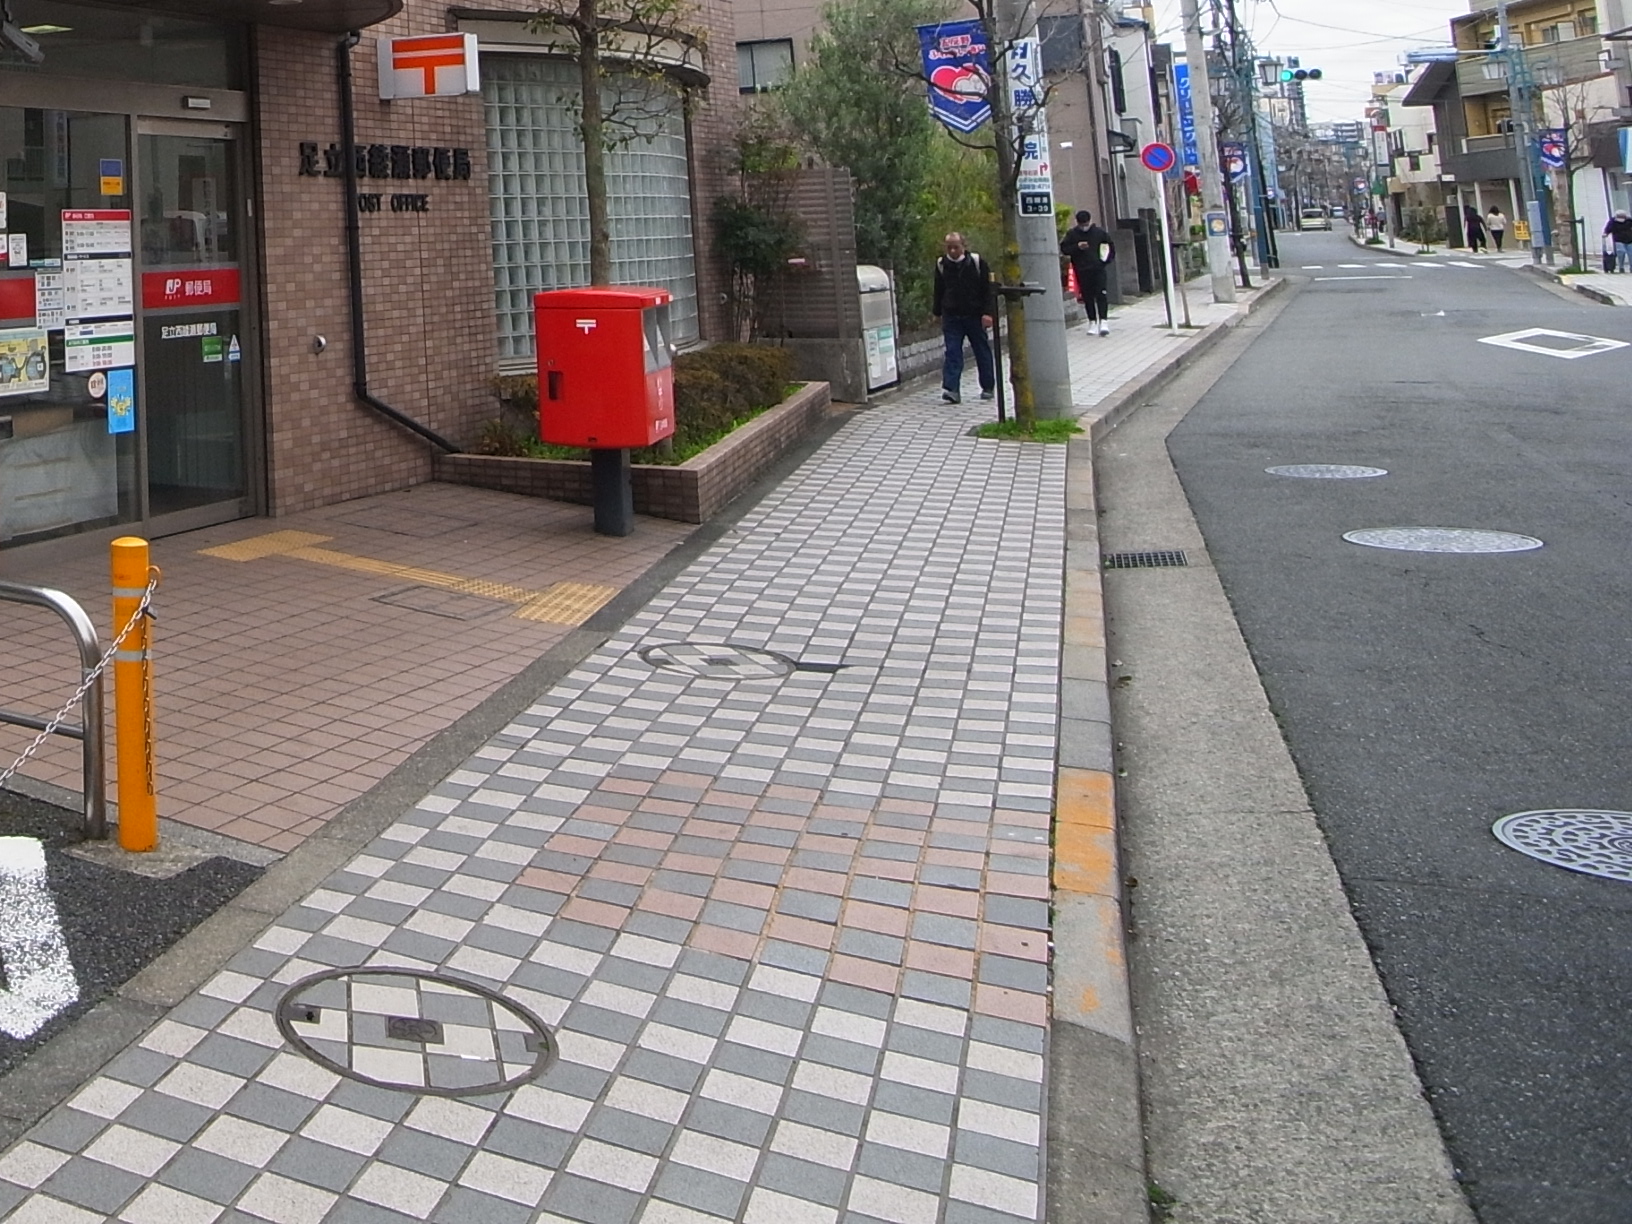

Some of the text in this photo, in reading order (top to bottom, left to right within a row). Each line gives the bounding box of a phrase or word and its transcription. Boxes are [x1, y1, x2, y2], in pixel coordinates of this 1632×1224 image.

[358, 194, 429, 212] OST OFFICE
[185, 279, 212, 296] 郵便局
